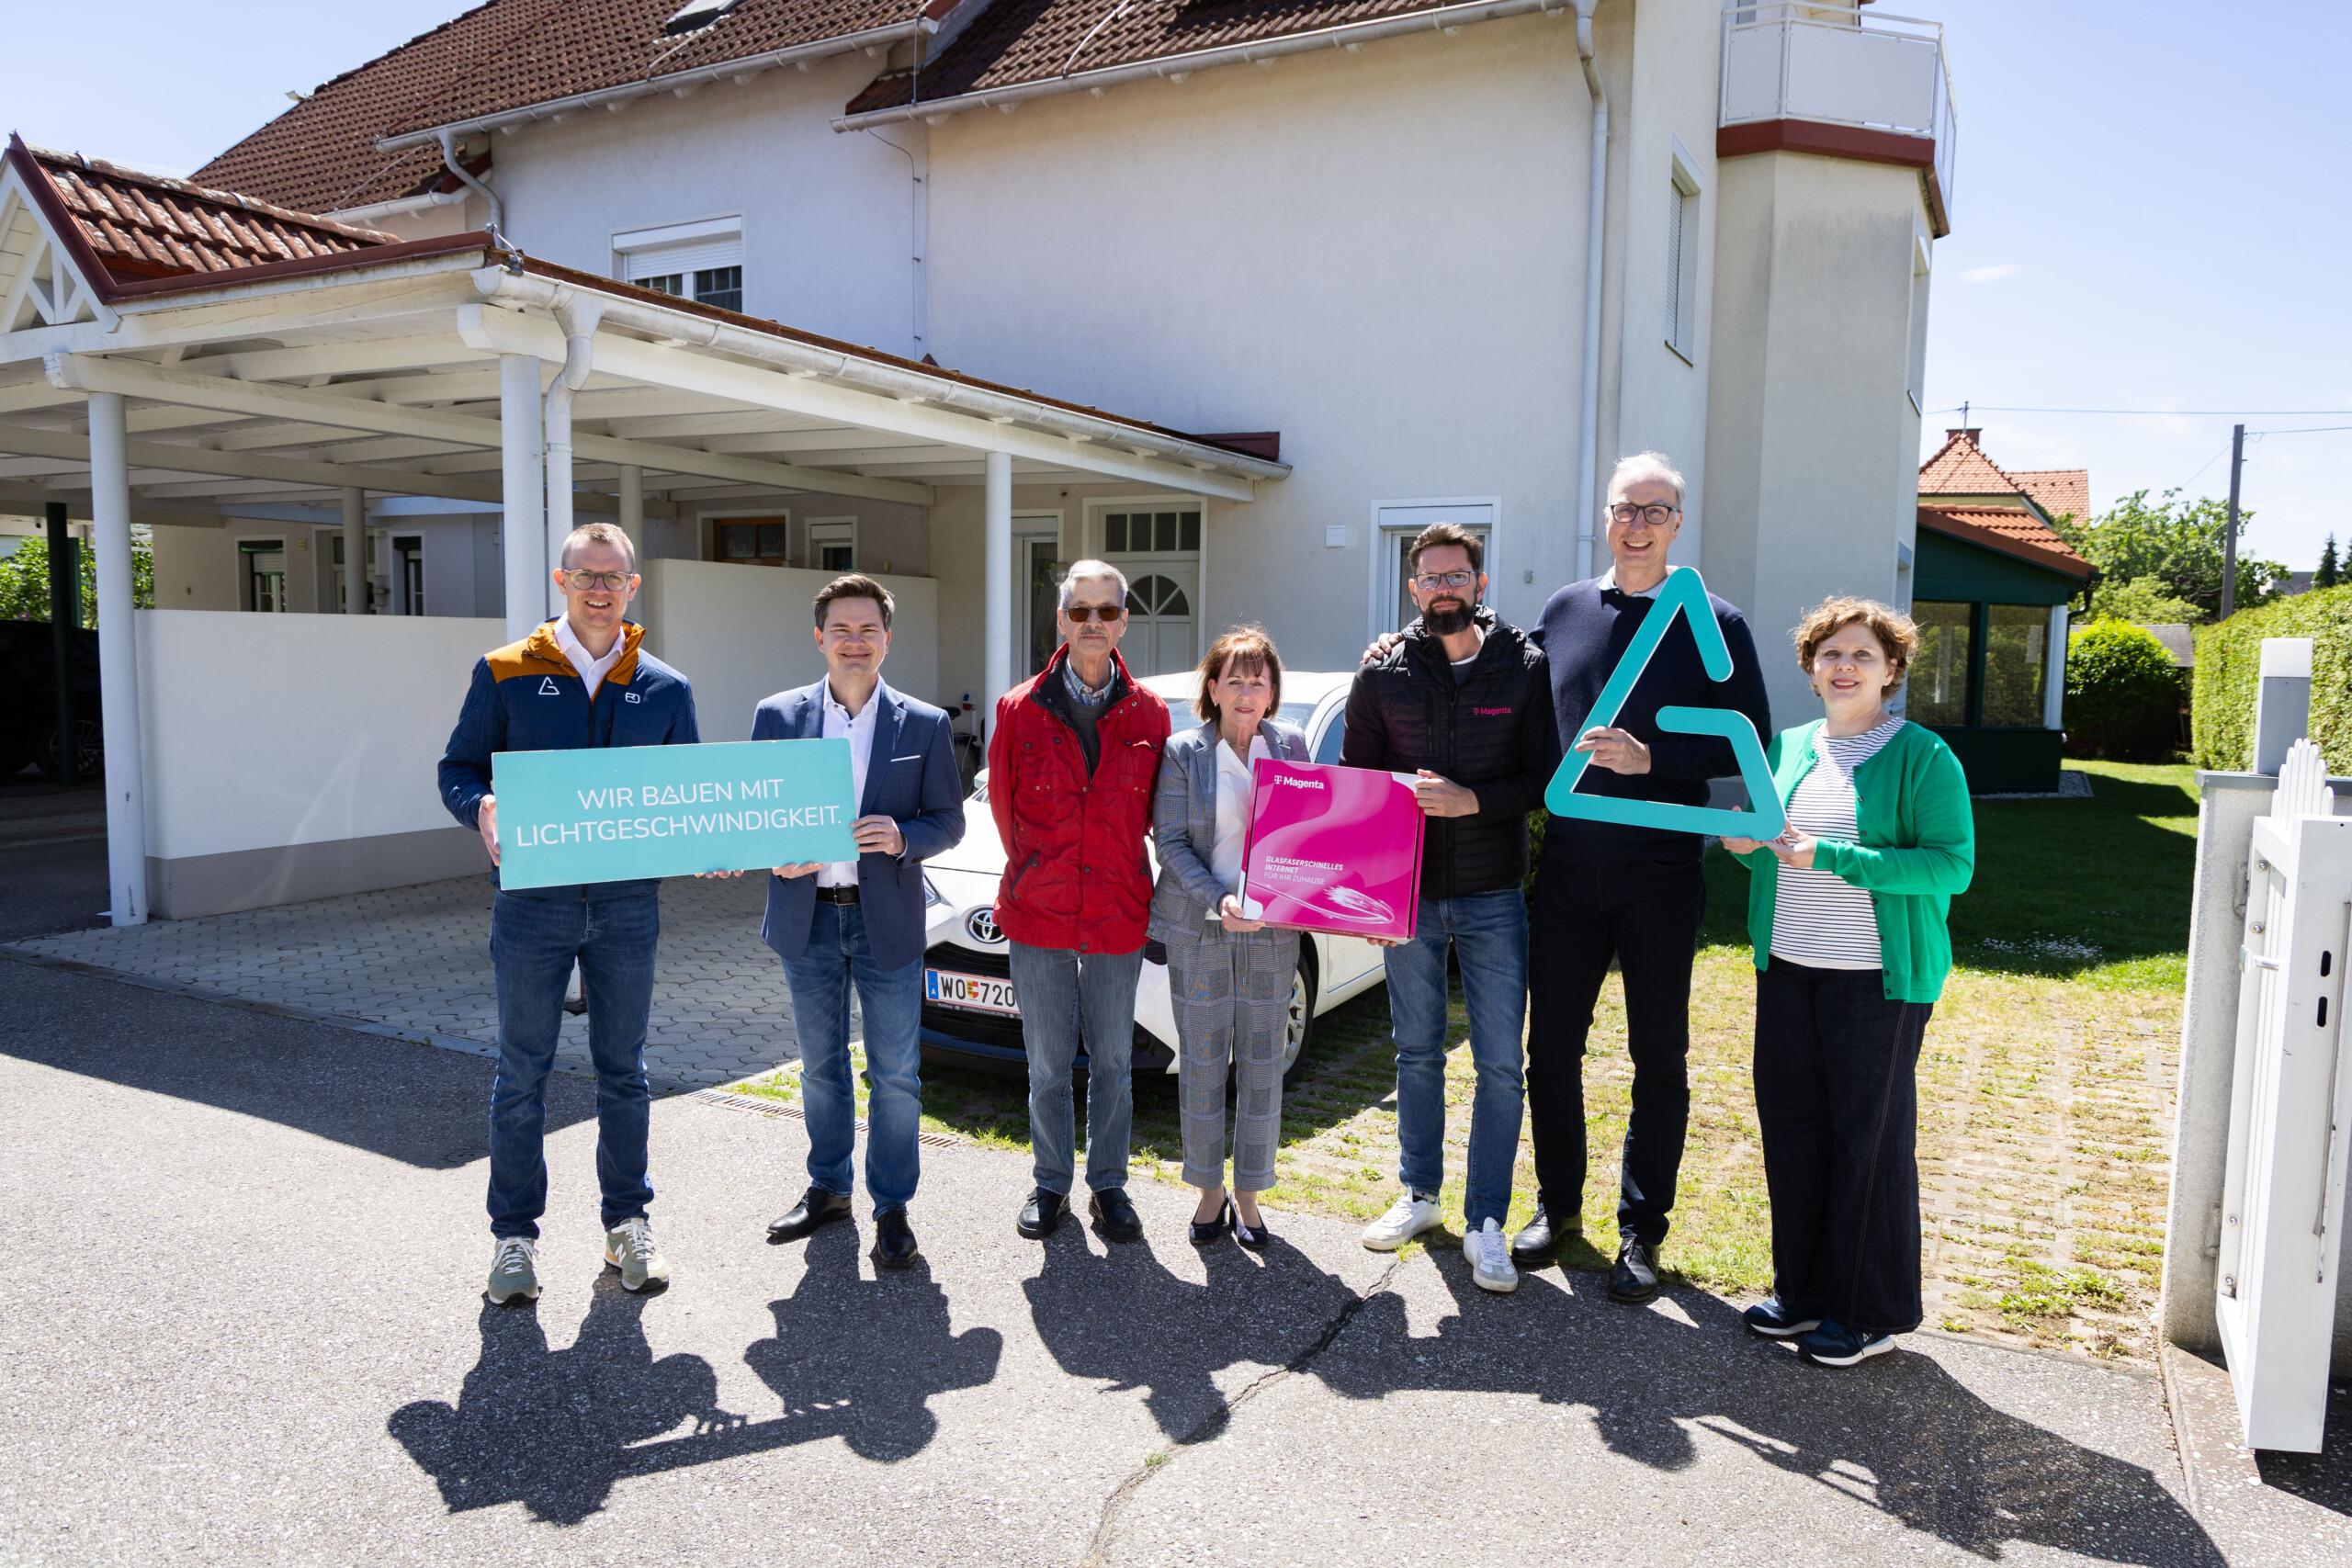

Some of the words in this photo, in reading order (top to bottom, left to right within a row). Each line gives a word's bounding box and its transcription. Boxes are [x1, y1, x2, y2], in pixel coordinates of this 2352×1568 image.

[1480, 706, 1512, 716] Magenta
[1283, 776, 1324, 789] Magenta
[577, 787, 634, 810] WIR
[642, 781, 732, 807] BAUEN
[741, 779, 784, 800] MIT
[516, 805, 842, 847] LICHTGESCHWINDIGKEIT.
[1264, 863, 1300, 874] INTERNET
[1265, 855, 1344, 871] GLASFASERSCHNELLES
[1264, 871, 1278, 880] FÜR
[1293, 874, 1326, 885] ZUHAUSE
[941, 976, 966, 999] WO
